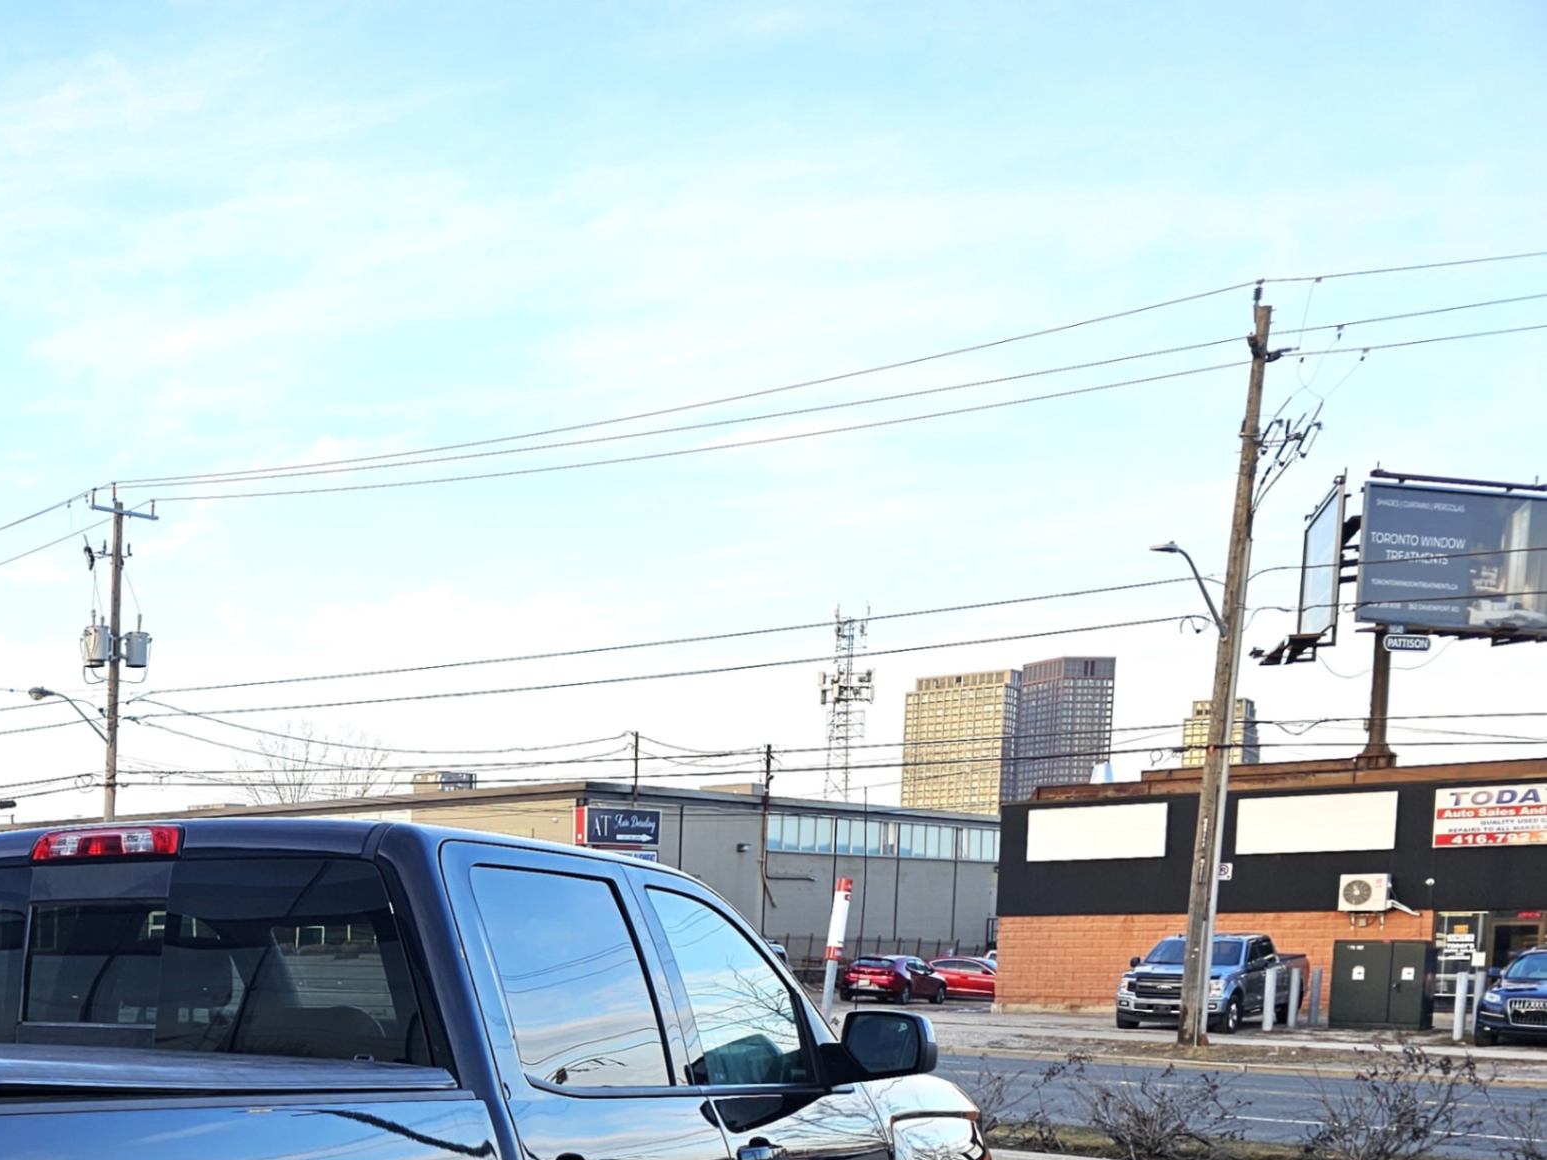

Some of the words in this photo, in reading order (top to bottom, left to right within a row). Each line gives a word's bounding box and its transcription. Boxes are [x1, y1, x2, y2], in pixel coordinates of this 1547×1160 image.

[1370, 531, 1419, 547] TORONTO
[1420, 535, 1467, 549] WINDOW
[1385, 549, 1449, 565] TREATMENTS
[1387, 638, 1429, 649] PATTISON
[1449, 787, 1547, 807] TODA
[1443, 808, 1475, 818] Auto
[1478, 807, 1516, 817] Sales
[1519, 806, 1547, 816] And
